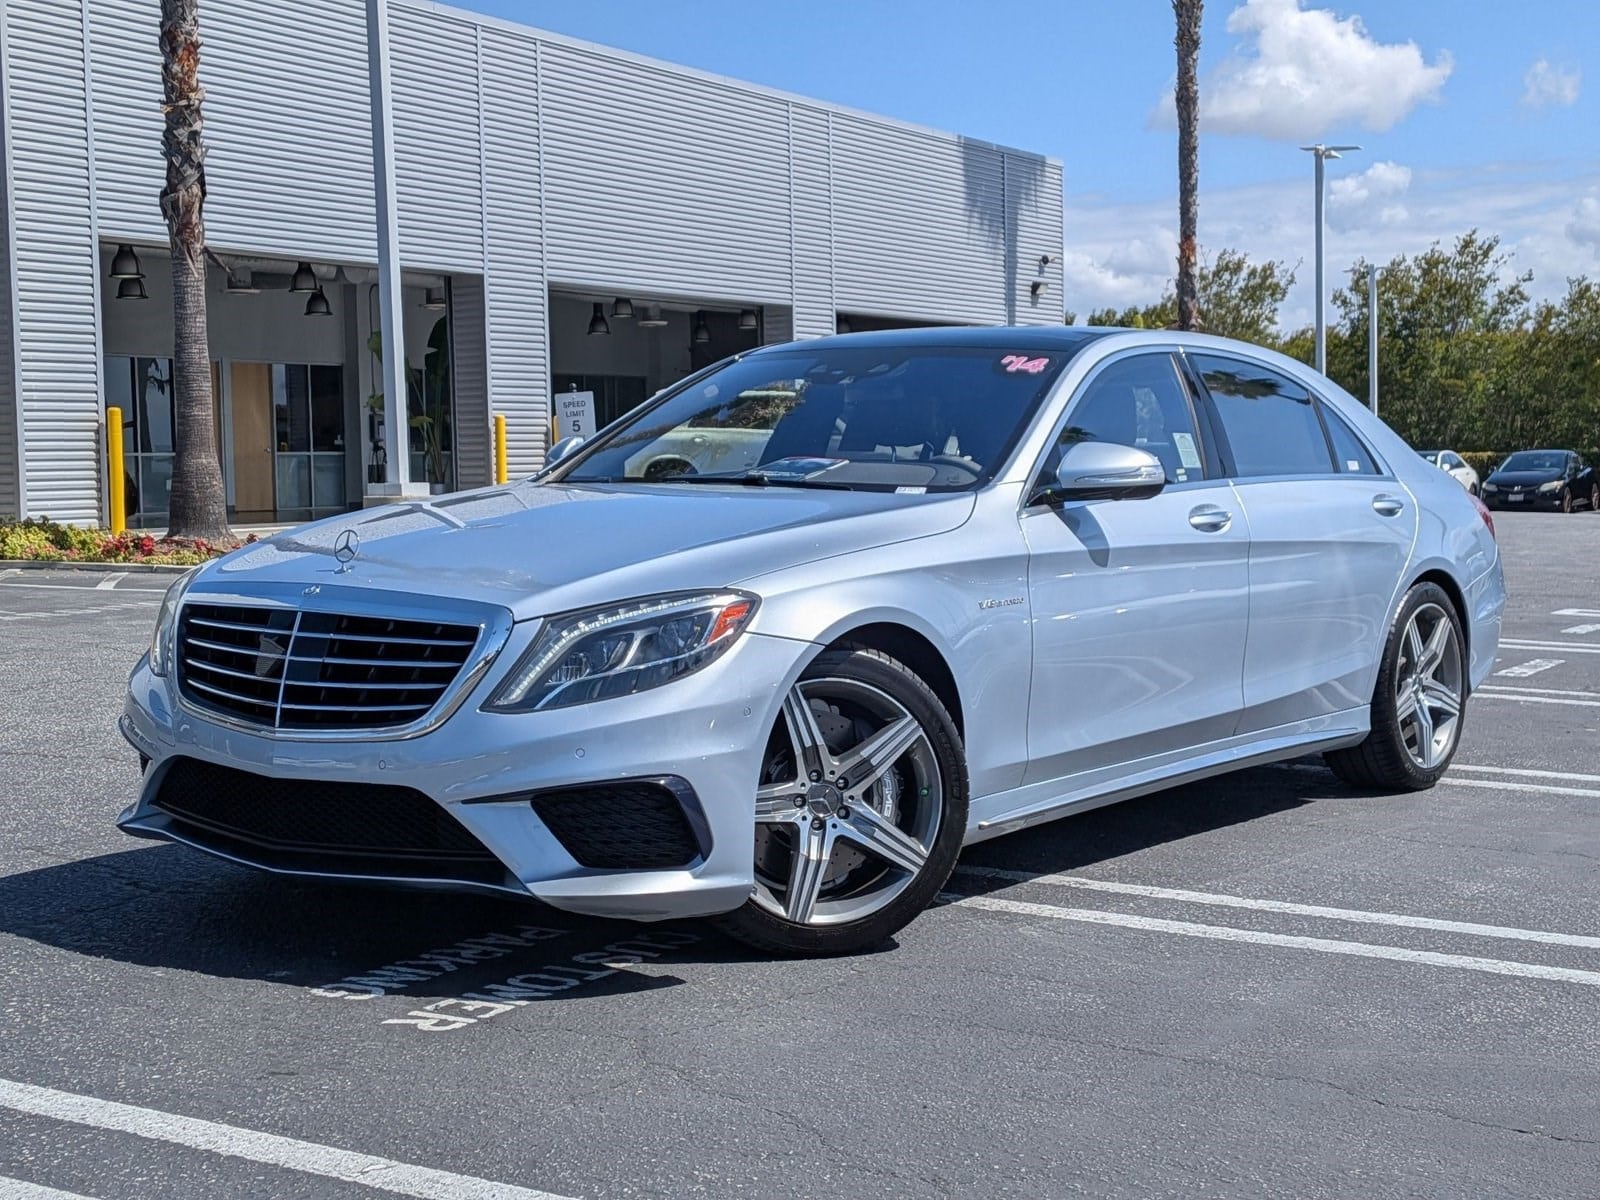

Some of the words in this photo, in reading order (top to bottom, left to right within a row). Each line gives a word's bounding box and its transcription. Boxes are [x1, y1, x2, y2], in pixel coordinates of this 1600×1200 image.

[572, 420, 581, 432] 5
[310, 924, 570, 1000] PARKING
[381, 929, 702, 1032] CUSTOMER
